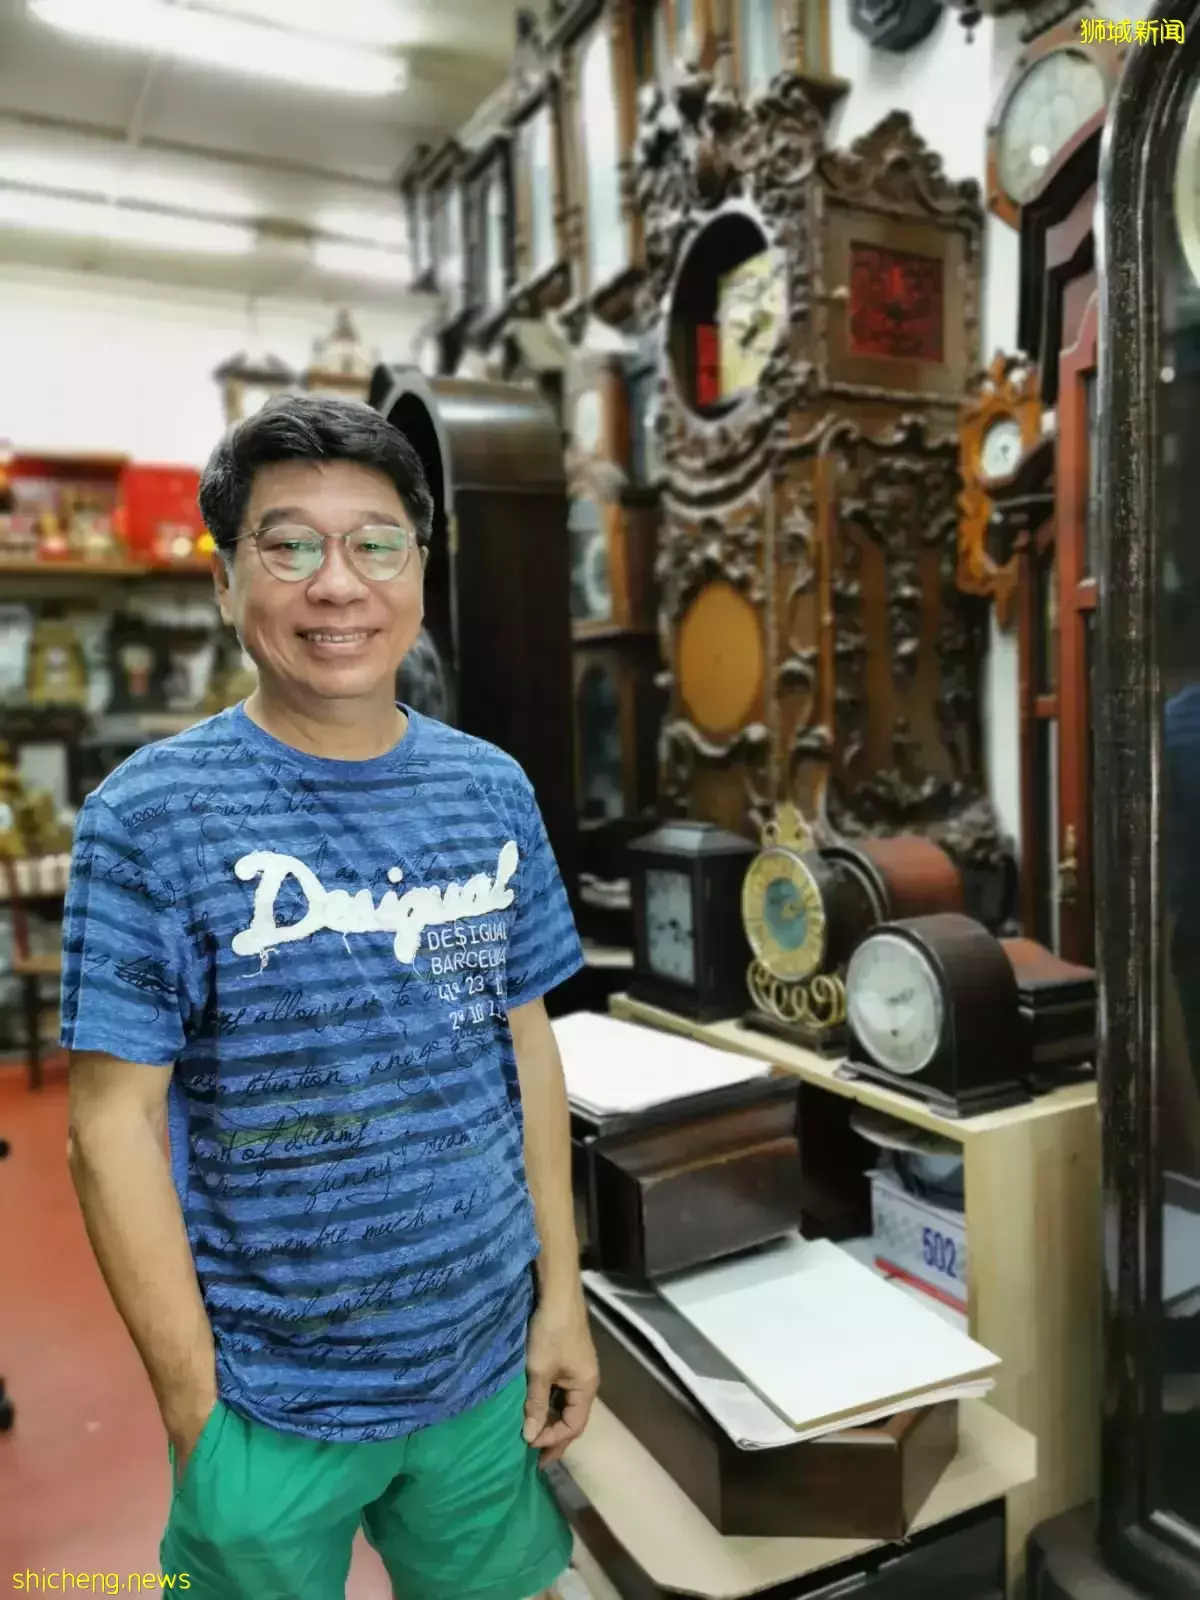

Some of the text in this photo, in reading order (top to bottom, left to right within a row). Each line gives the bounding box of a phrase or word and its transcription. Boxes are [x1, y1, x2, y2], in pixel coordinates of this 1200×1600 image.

[231, 840, 519, 964] Desigual
[465, 975, 485, 995] 23
[469, 1003, 485, 1023] 10
[921, 1226, 957, 1279] 502
